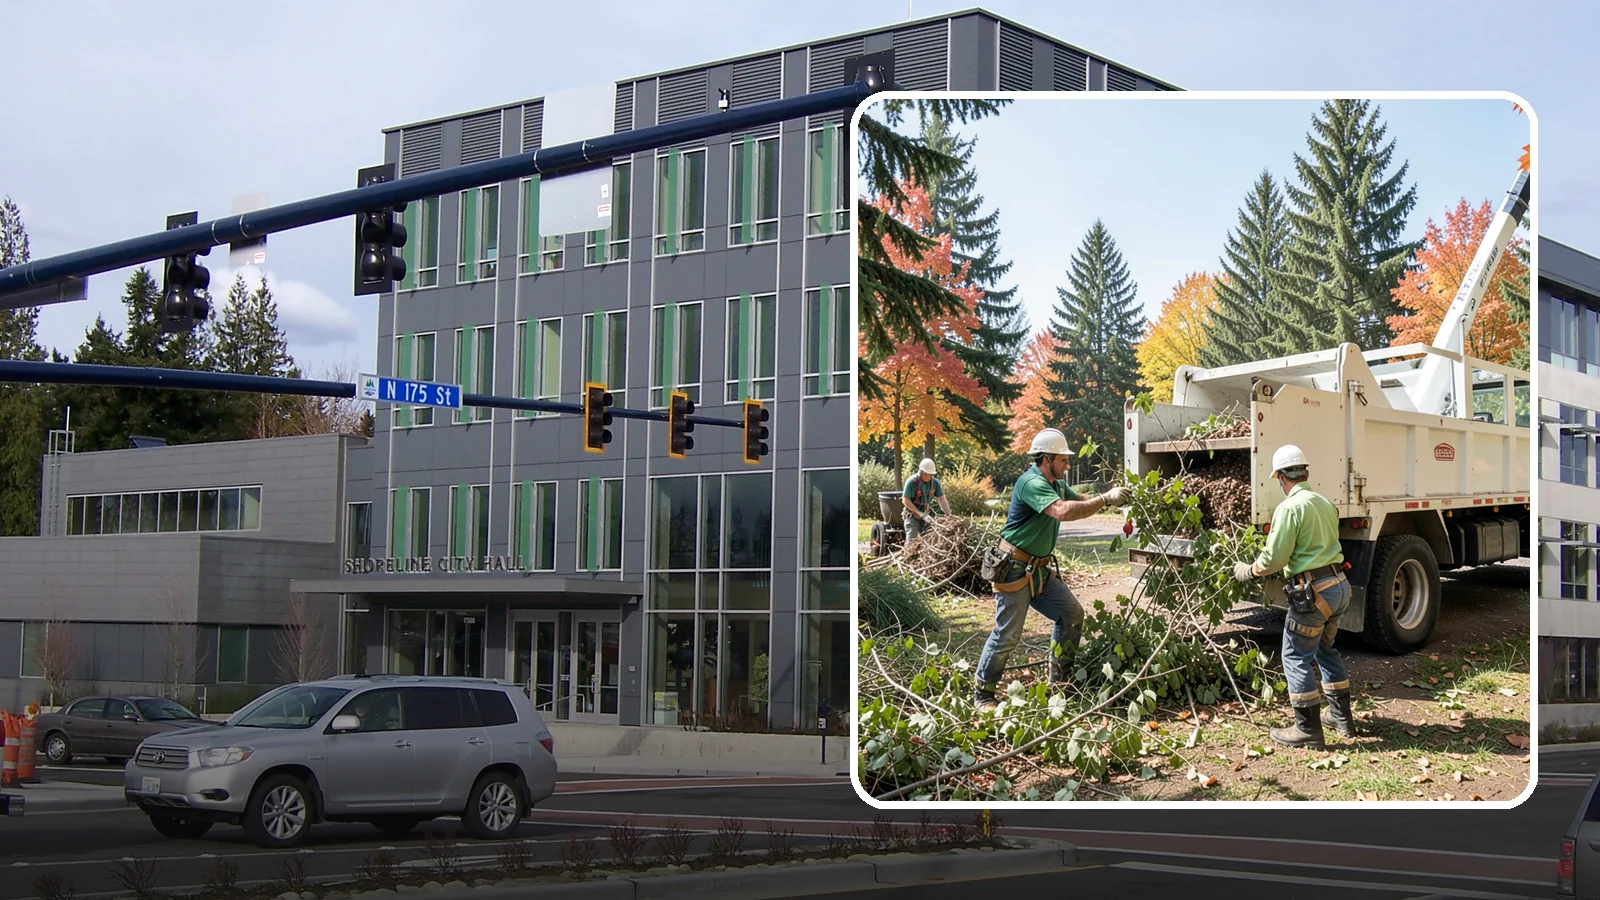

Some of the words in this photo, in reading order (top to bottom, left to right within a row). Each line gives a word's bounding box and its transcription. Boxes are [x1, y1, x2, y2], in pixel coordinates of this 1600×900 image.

[387, 380, 396, 400] N
[405, 382, 428, 403] 175
[436, 386, 452, 406] St
[344, 557, 432, 574] SHORELINE
[439, 556, 476, 572] CITY
[484, 555, 525, 572] HALL
